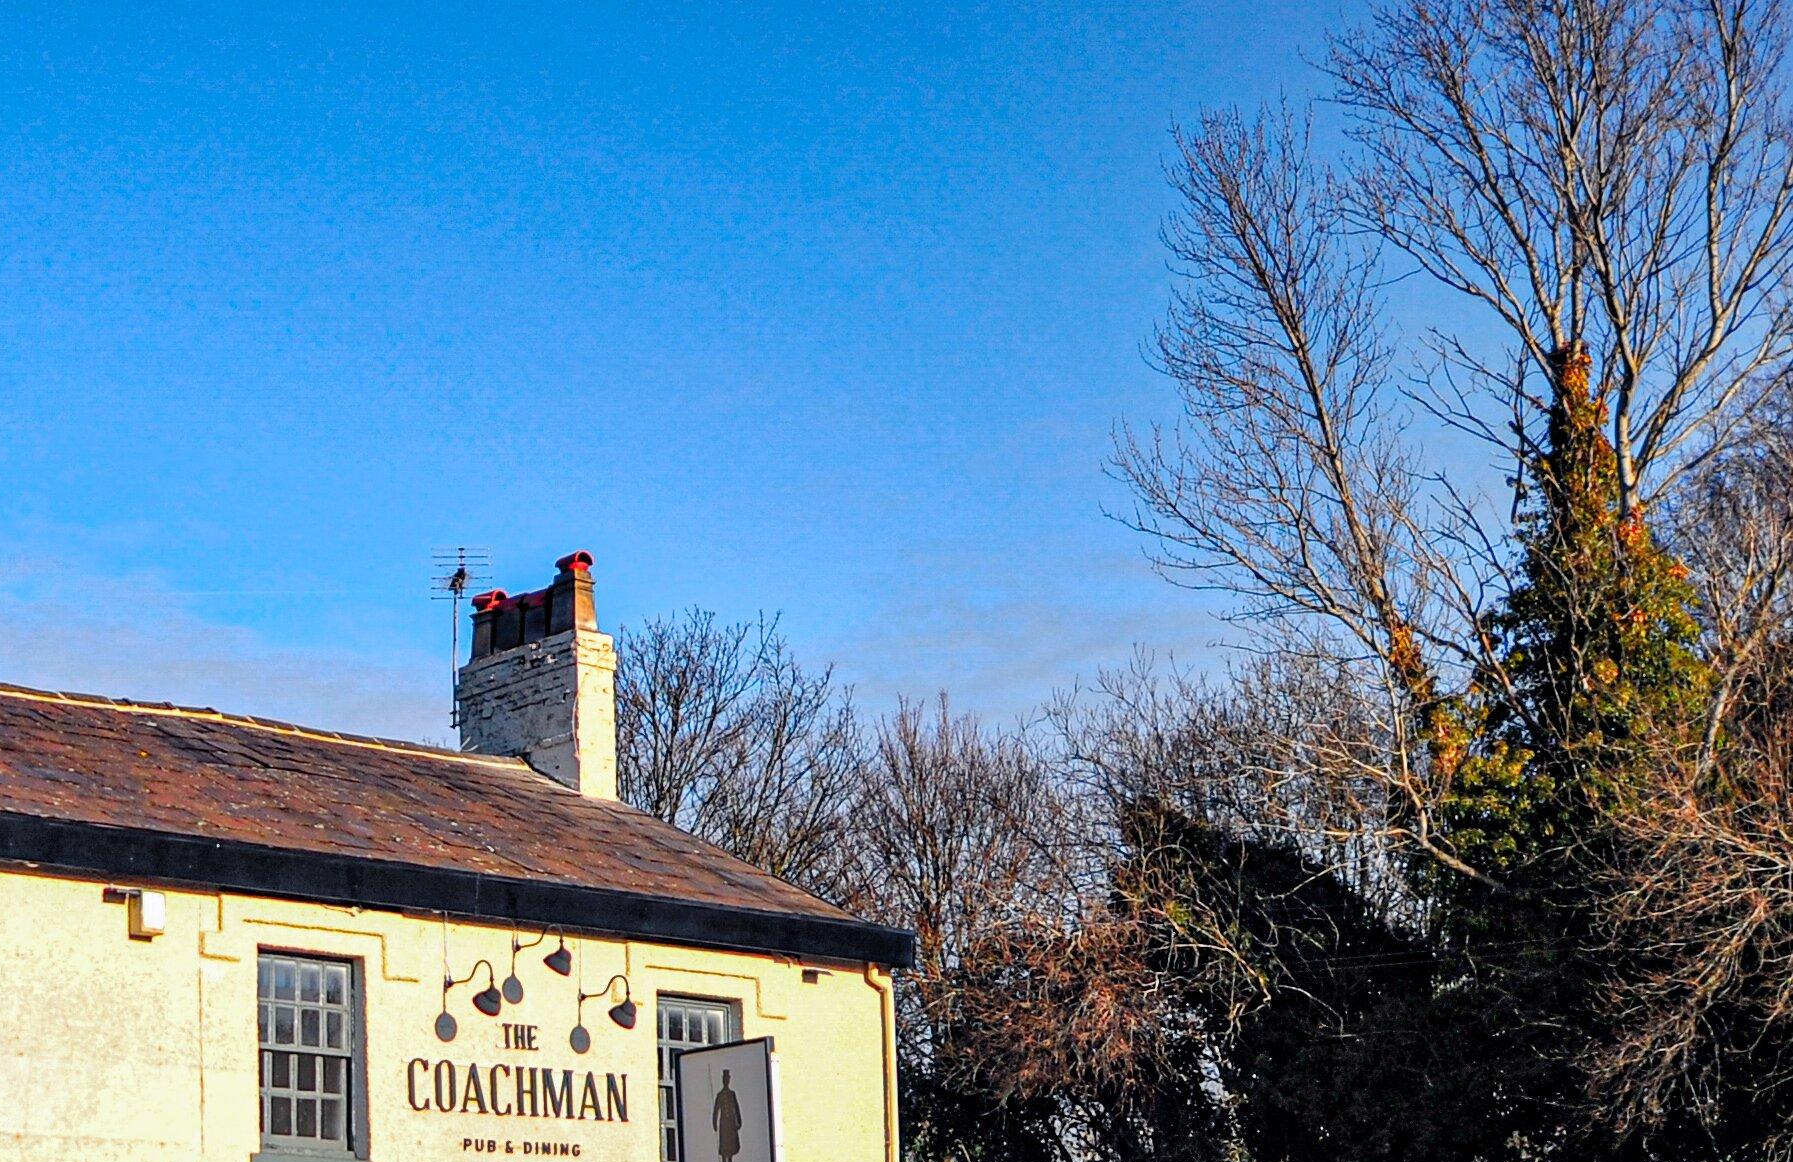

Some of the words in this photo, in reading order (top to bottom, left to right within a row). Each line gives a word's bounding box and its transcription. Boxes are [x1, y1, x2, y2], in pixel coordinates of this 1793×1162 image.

[502, 1023, 539, 1051] THE
[407, 1058, 630, 1123] COACHMAN
[462, 1138, 497, 1153] PUB
[505, 1140, 514, 1154] &
[523, 1141, 582, 1157] DINING
